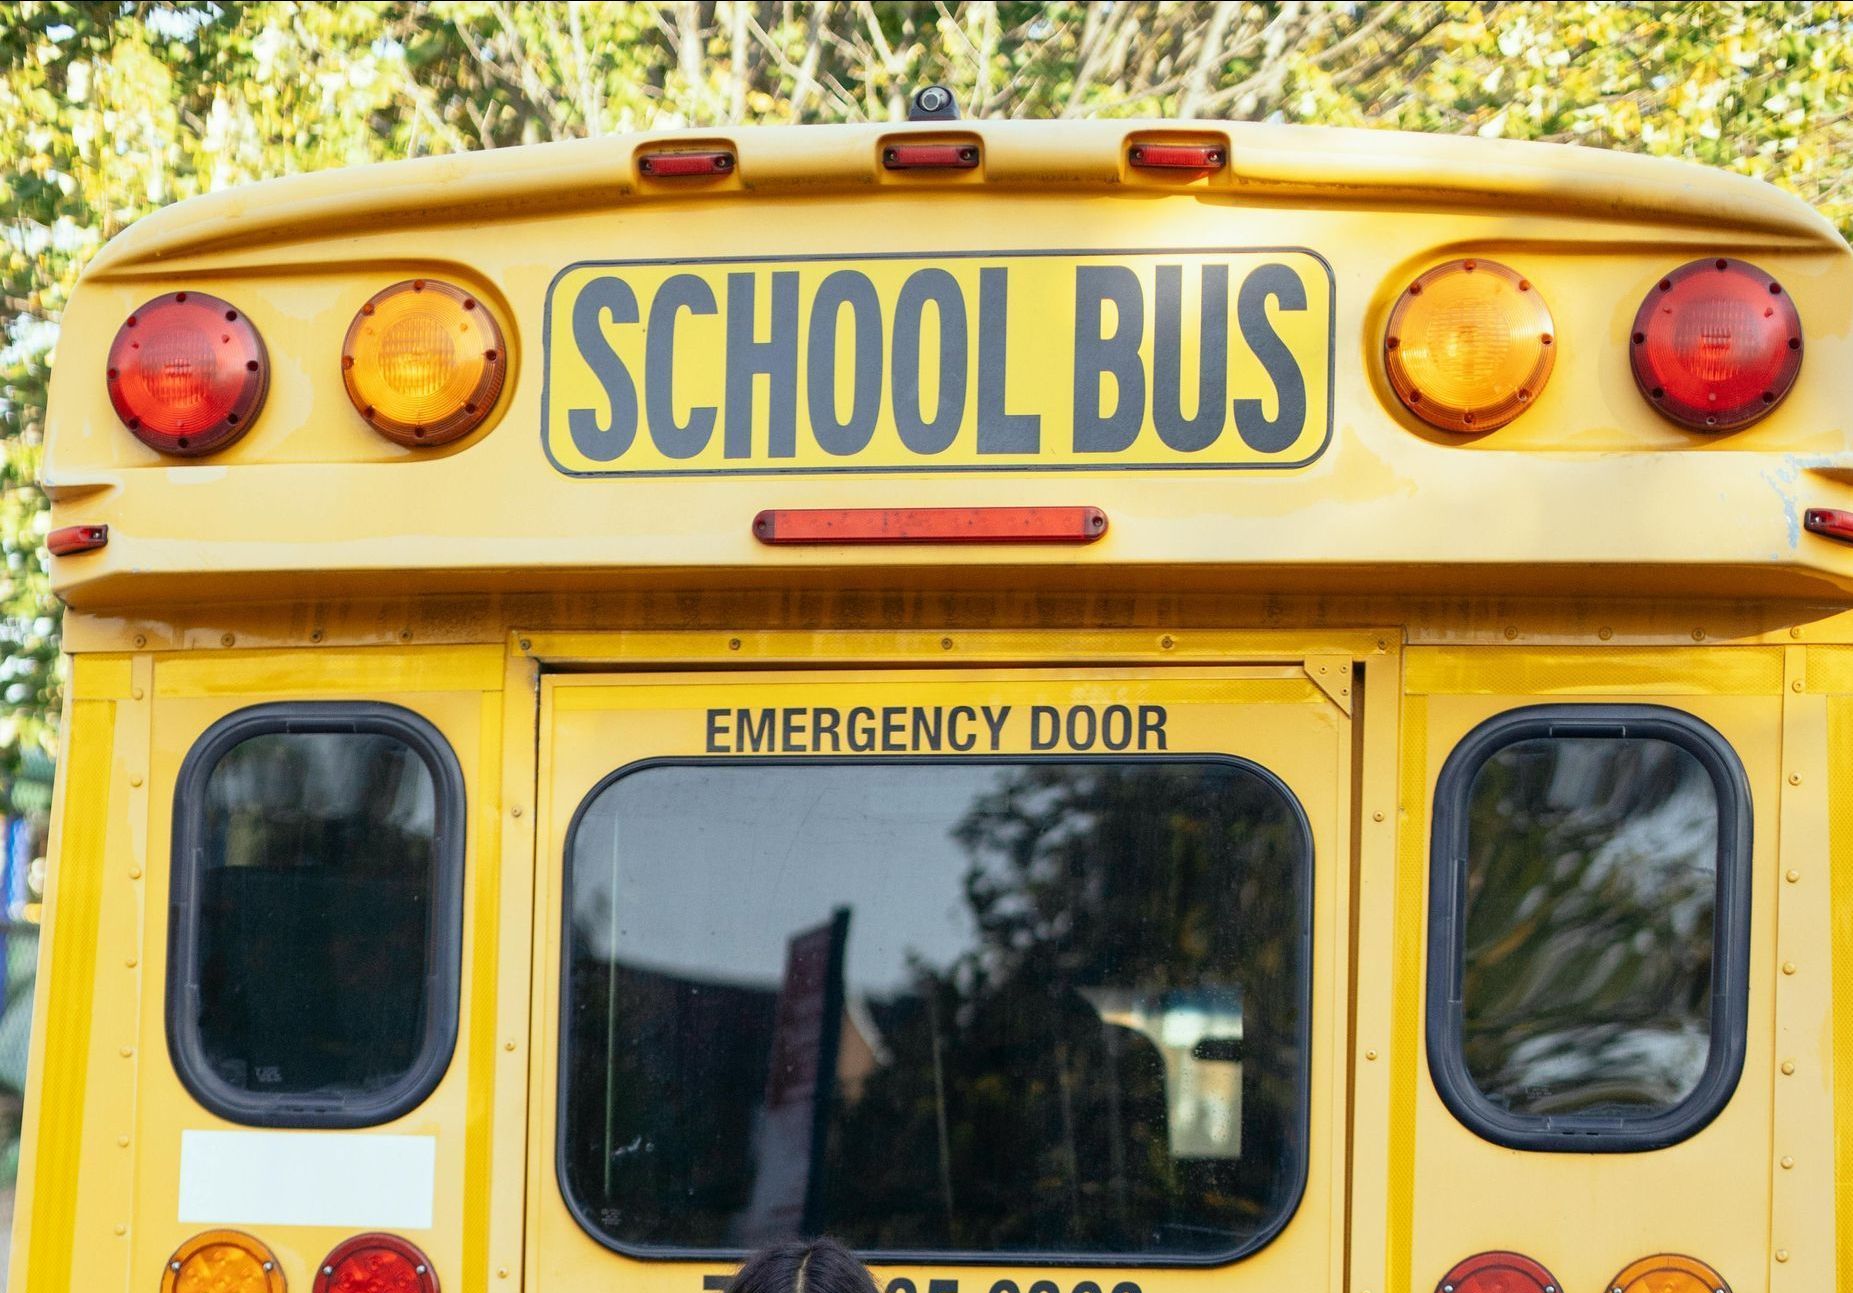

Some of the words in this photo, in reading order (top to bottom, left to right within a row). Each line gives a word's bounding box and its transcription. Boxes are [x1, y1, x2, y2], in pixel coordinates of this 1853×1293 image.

[568, 267, 1041, 461] SCHOOL
[1072, 263, 1307, 454] BUS
[705, 706, 1011, 753] EMERGENCY
[1030, 704, 1168, 751] DOOR
